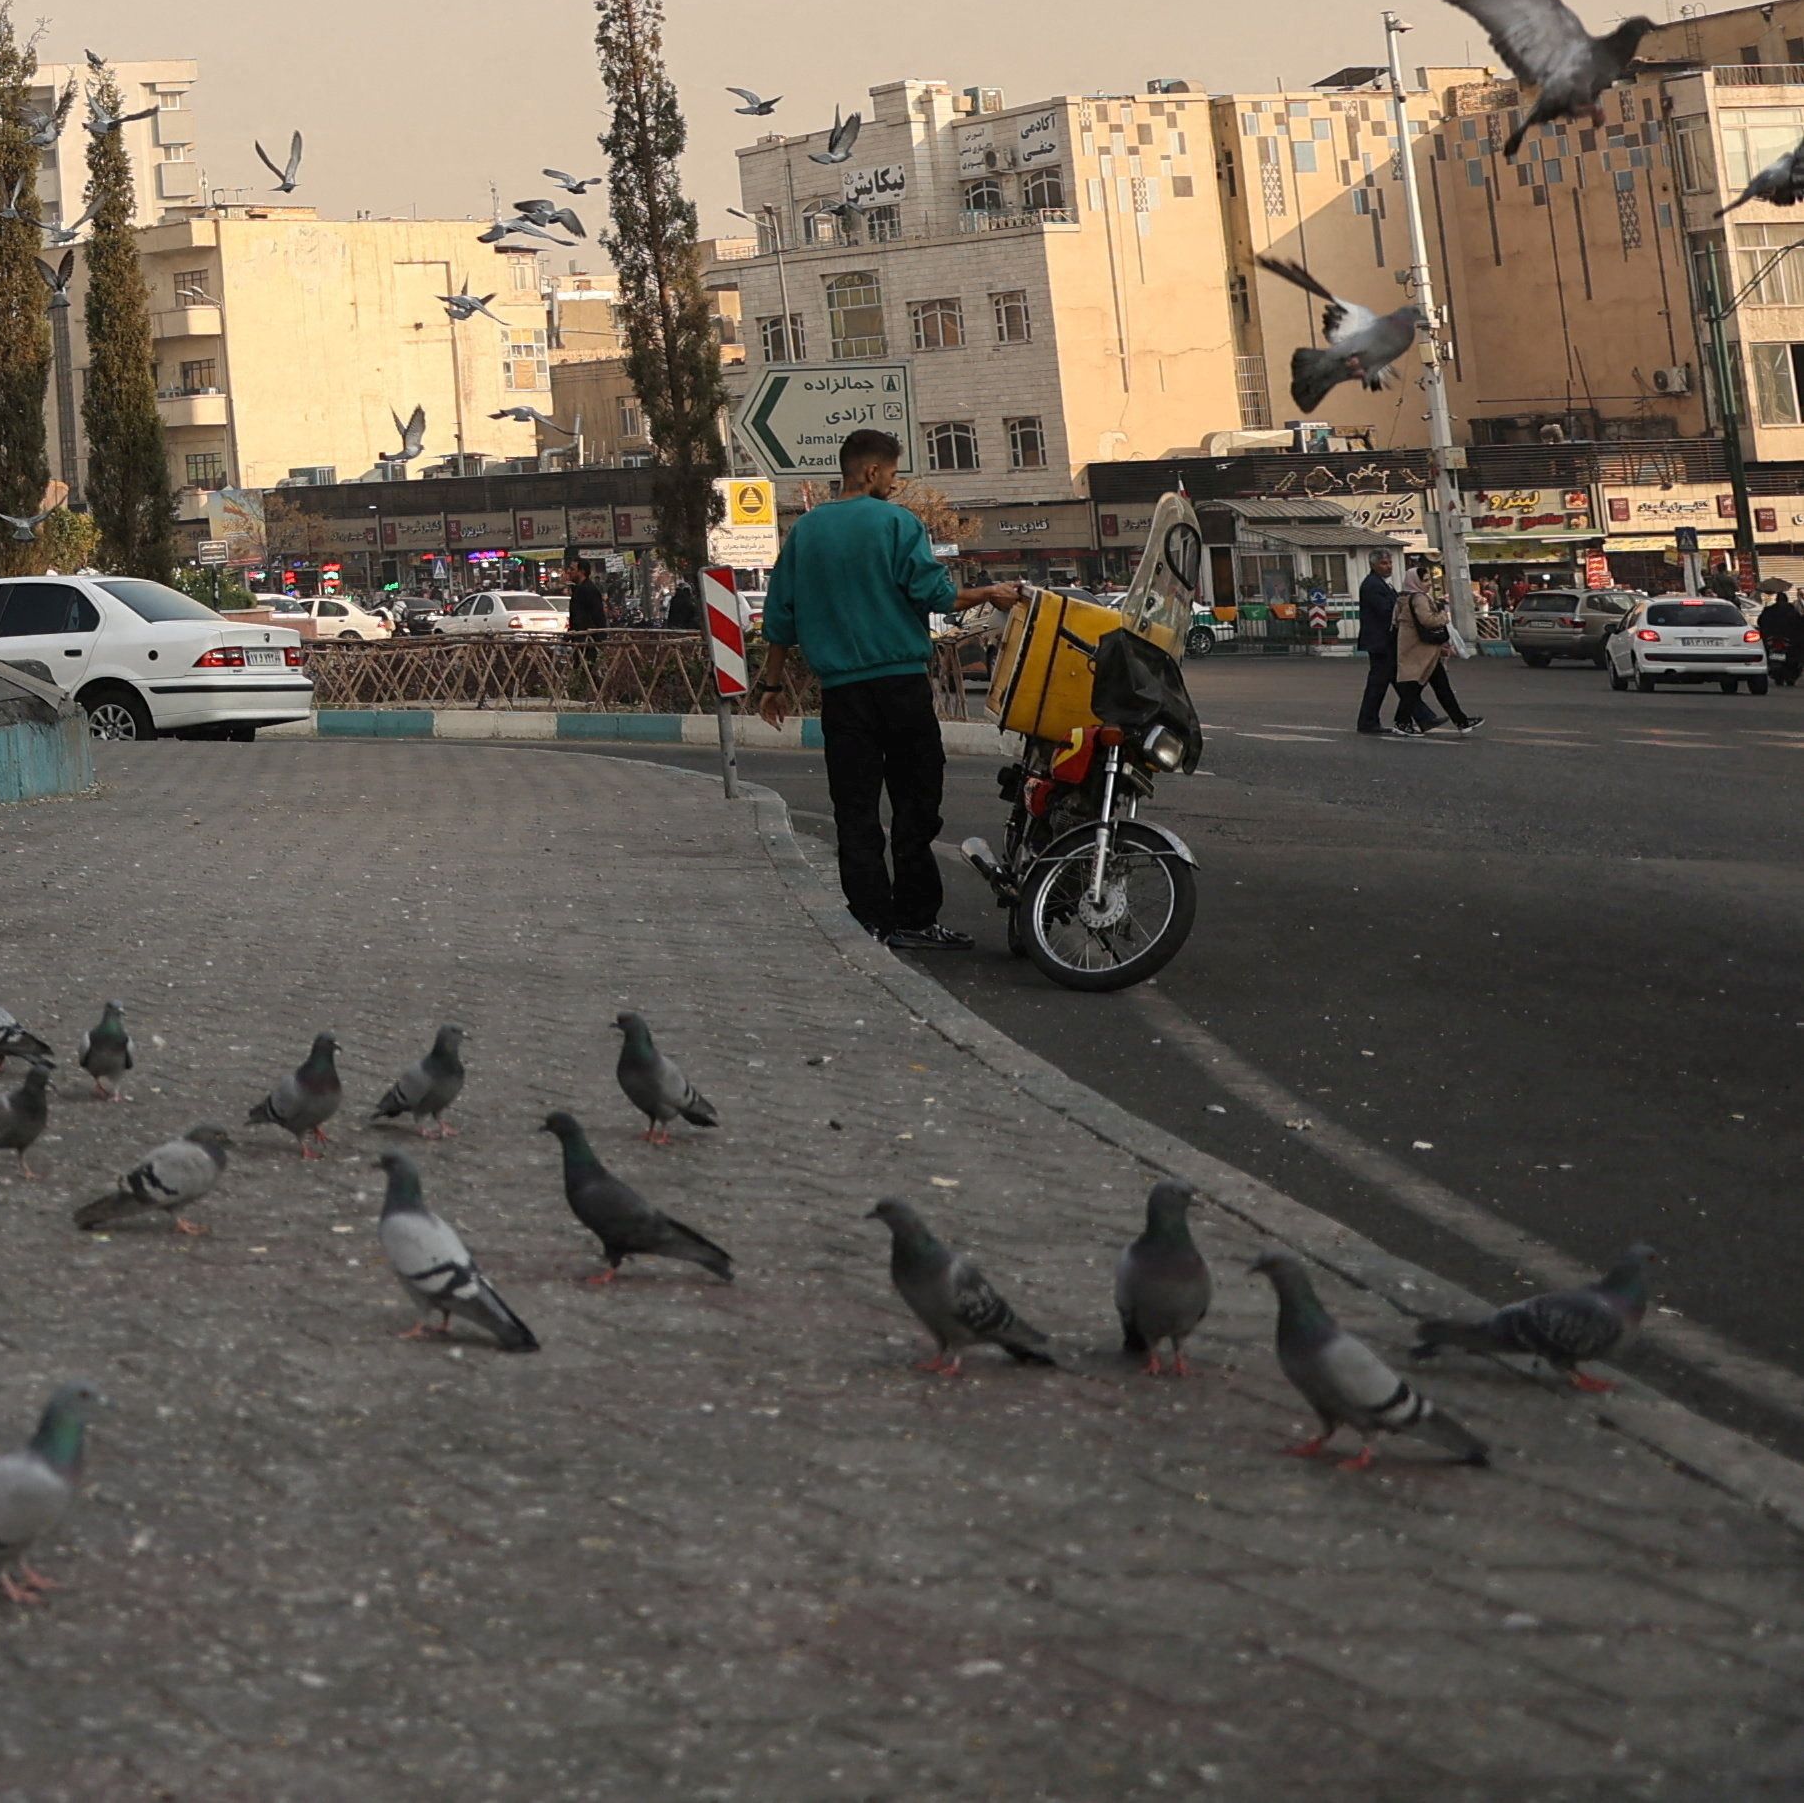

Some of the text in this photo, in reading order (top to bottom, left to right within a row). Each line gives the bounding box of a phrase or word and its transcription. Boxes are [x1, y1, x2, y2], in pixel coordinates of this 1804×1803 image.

[1020, 113, 1057, 139] آکادمی
[1022, 140, 1056, 162] حنفی
[804, 375, 874, 395] جمالزاده
[825, 403, 876, 425] آزادی
[798, 455, 837, 467] Azadi
[1375, 492, 1415, 527] دکتر
[998, 517, 1049, 535] قنادی سینا
